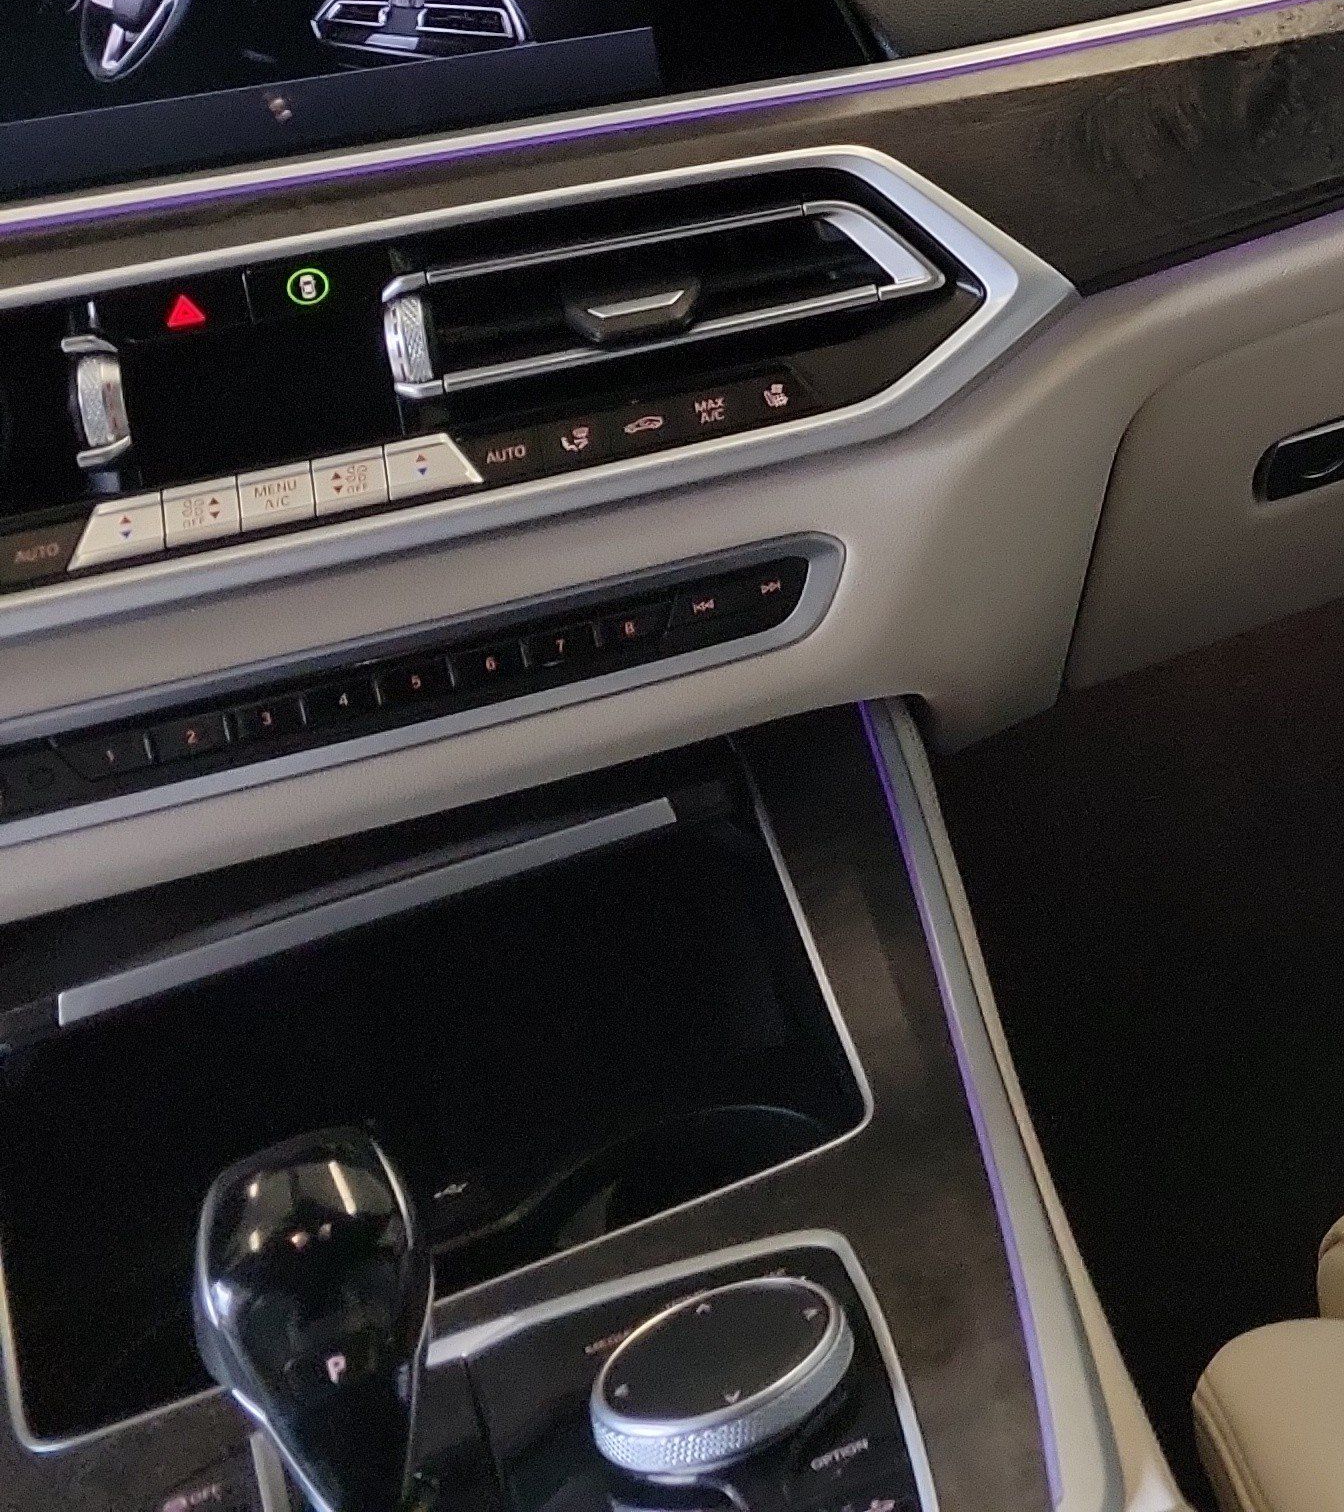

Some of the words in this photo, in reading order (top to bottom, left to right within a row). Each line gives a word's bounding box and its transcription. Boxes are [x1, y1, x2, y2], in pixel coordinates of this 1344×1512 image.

[695, 397, 726, 414] MAX
[700, 409, 726, 424] A/C
[486, 444, 527, 464] AUTO
[254, 479, 298, 499] MENU
[264, 495, 290, 511] A/C
[15, 541, 59, 562] AUTO
[624, 620, 636, 636] 8
[555, 637, 566, 653] 7
[485, 656, 497, 671] 6
[411, 674, 422, 689] 5
[338, 692, 349, 707] 4
[261, 710, 272, 726] 3
[186, 729, 198, 745] 2
[105, 749, 115, 763] 1
[326, 1354, 347, 1384] P
